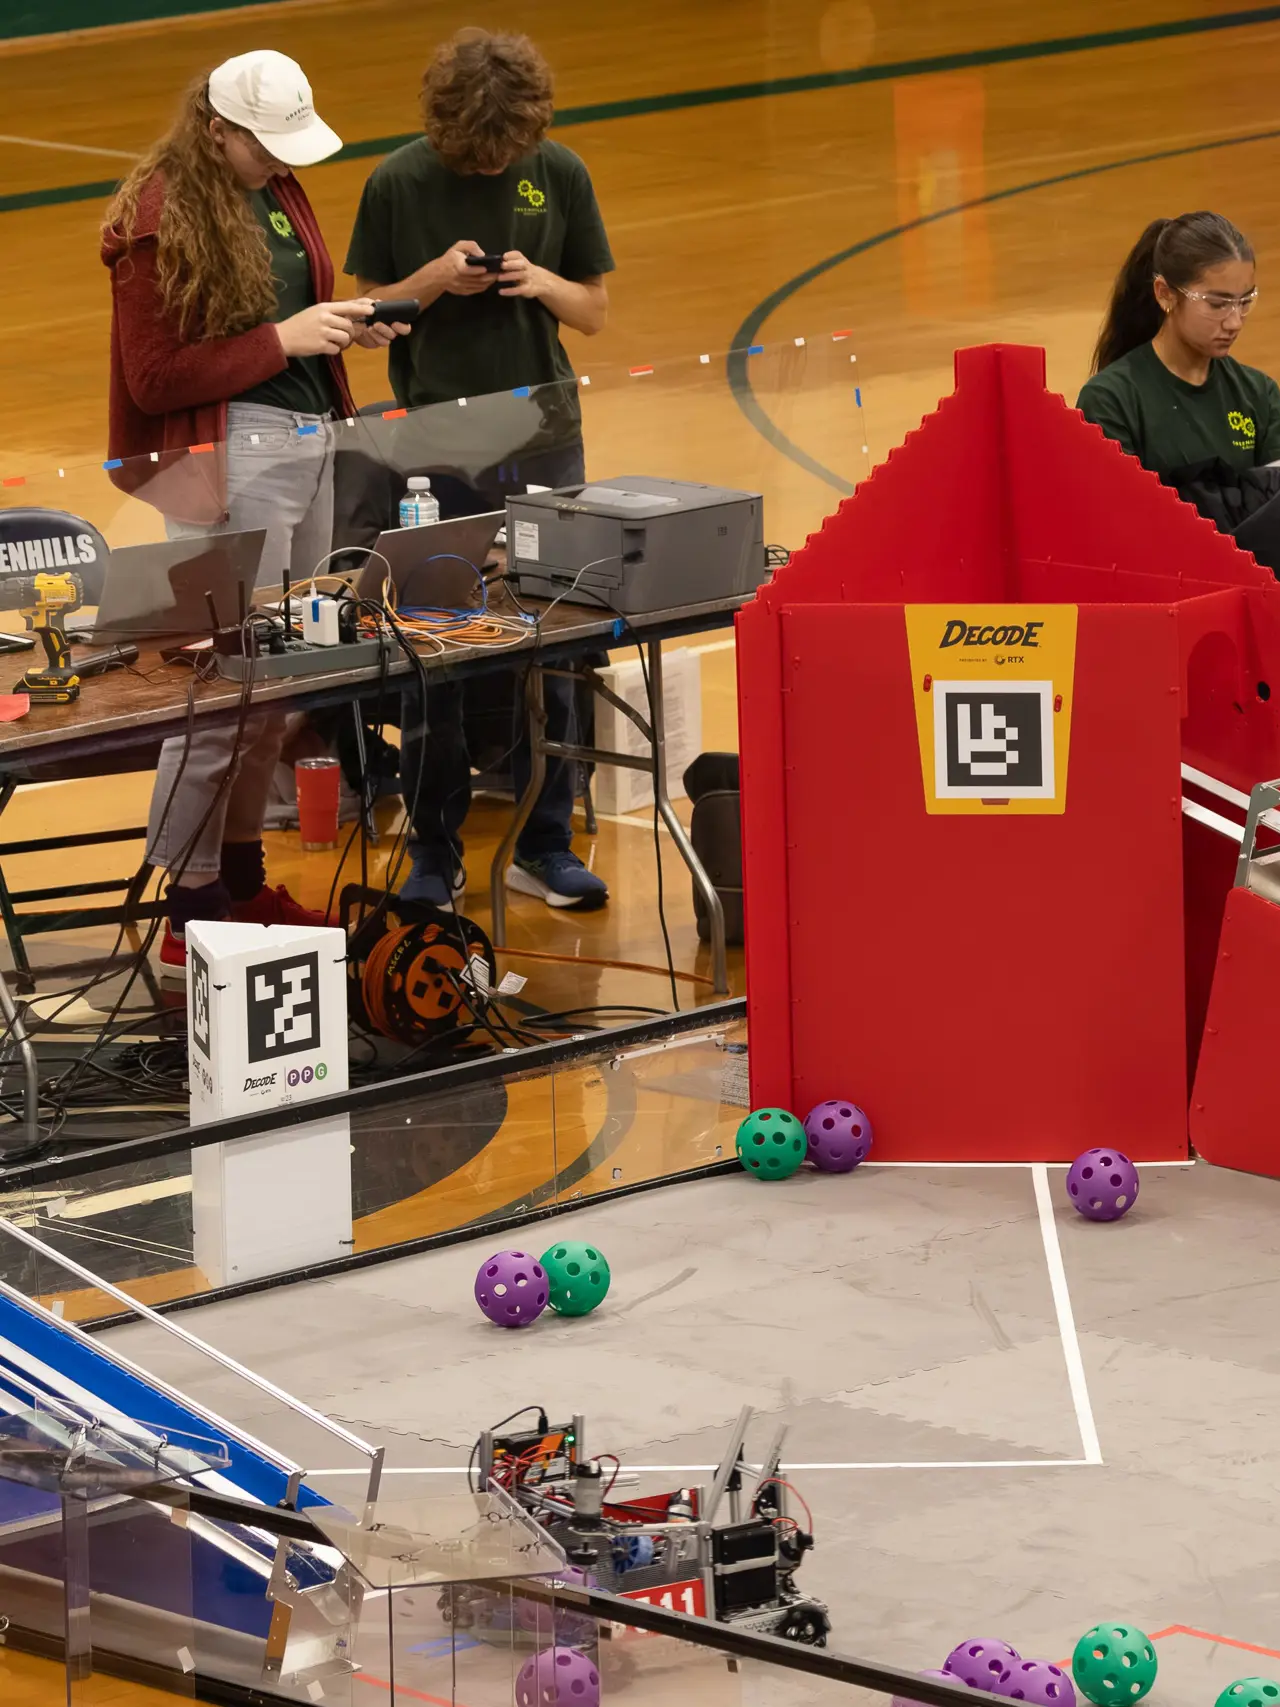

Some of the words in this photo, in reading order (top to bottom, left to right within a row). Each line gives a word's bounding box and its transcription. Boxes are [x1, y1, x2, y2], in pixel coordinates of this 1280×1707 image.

[0, 533, 97, 573] ENHILLS
[938, 619, 1044, 649] DECODE
[1007, 655, 1025, 664] RTX
[243, 1072, 278, 1092] DECODE
